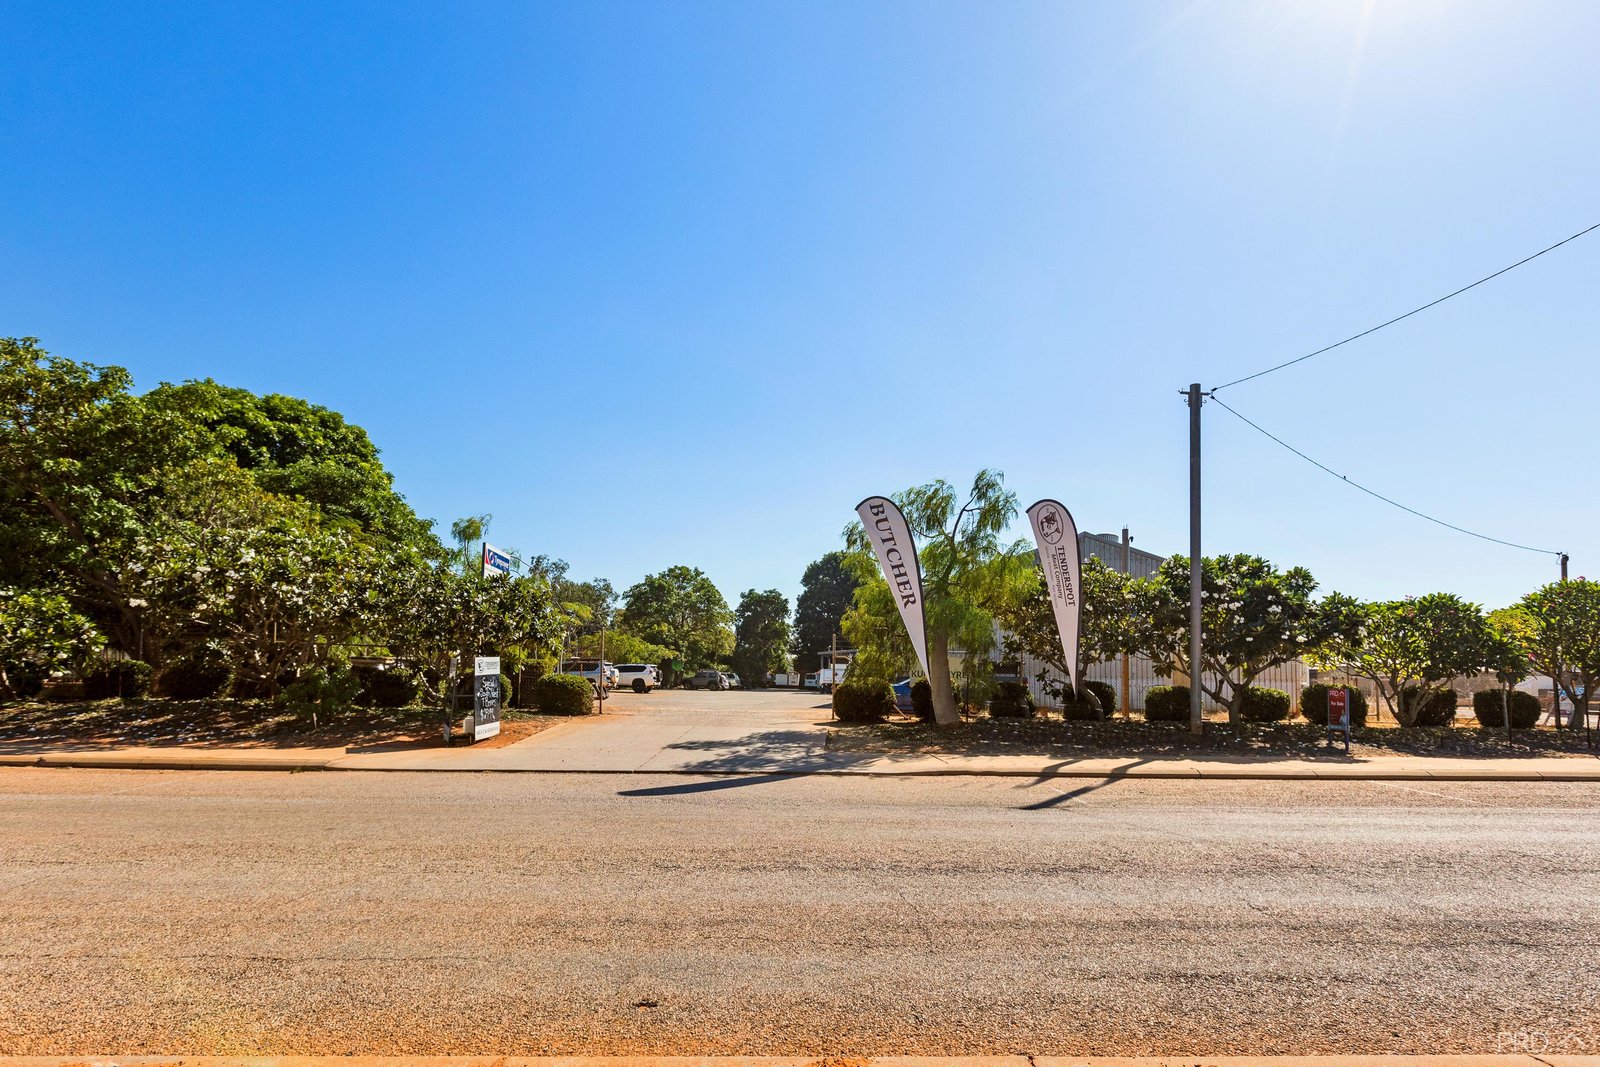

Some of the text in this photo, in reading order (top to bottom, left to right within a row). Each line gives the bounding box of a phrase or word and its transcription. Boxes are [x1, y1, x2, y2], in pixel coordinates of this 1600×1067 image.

[869, 502, 917, 609] BUTCHER
[1051, 553, 1059, 570] Meat
[1057, 545, 1076, 607] TENDERSPOT
[1054, 570, 1064, 600] Company
